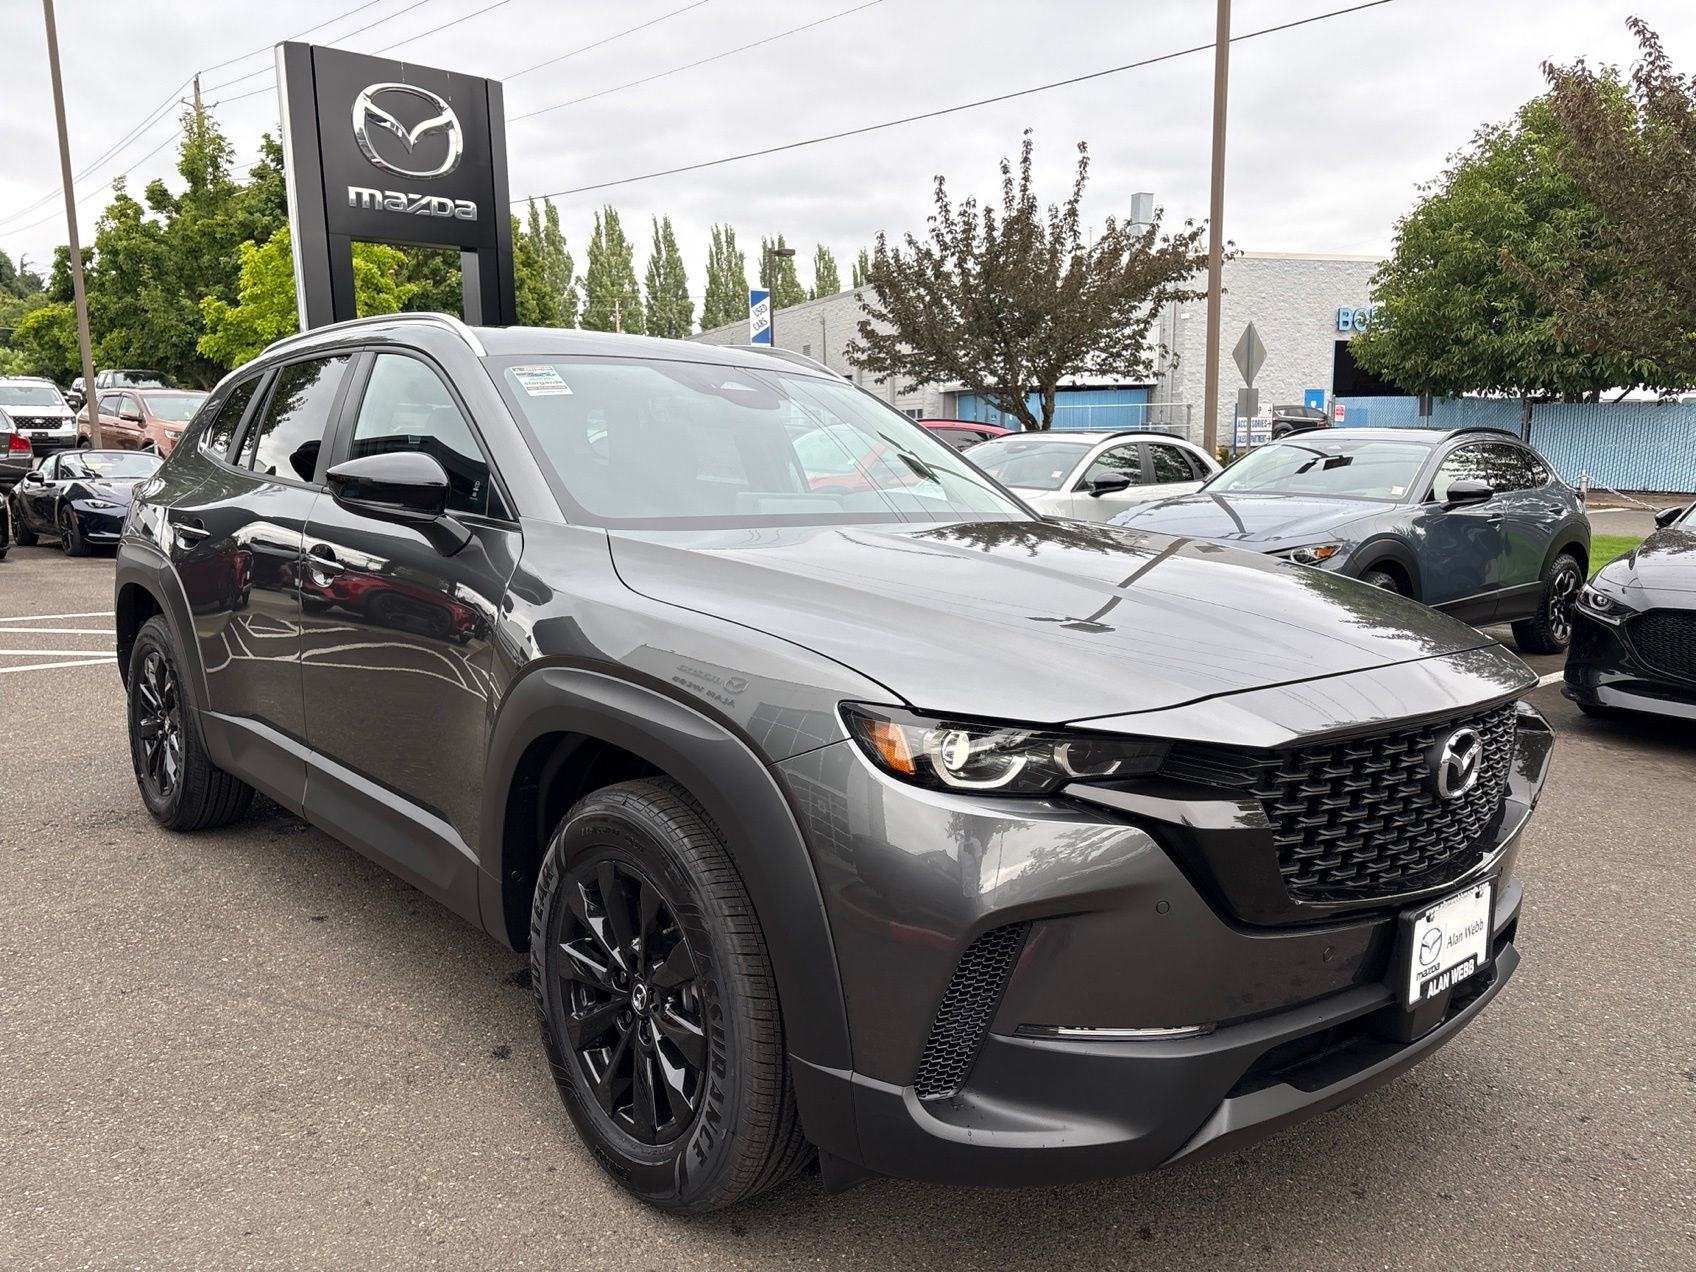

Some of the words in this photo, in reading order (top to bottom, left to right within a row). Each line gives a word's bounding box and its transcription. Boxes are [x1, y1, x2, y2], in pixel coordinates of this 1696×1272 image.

[752, 303, 768, 317] USED
[752, 317, 768, 331] CARS
[1238, 419, 1267, 428] ACCSORIES
[1446, 932, 1463, 949] Alan
[1464, 919, 1484, 939] Webb
[1427, 971, 1450, 999] ALAN
[1451, 959, 1475, 985] WEBB
